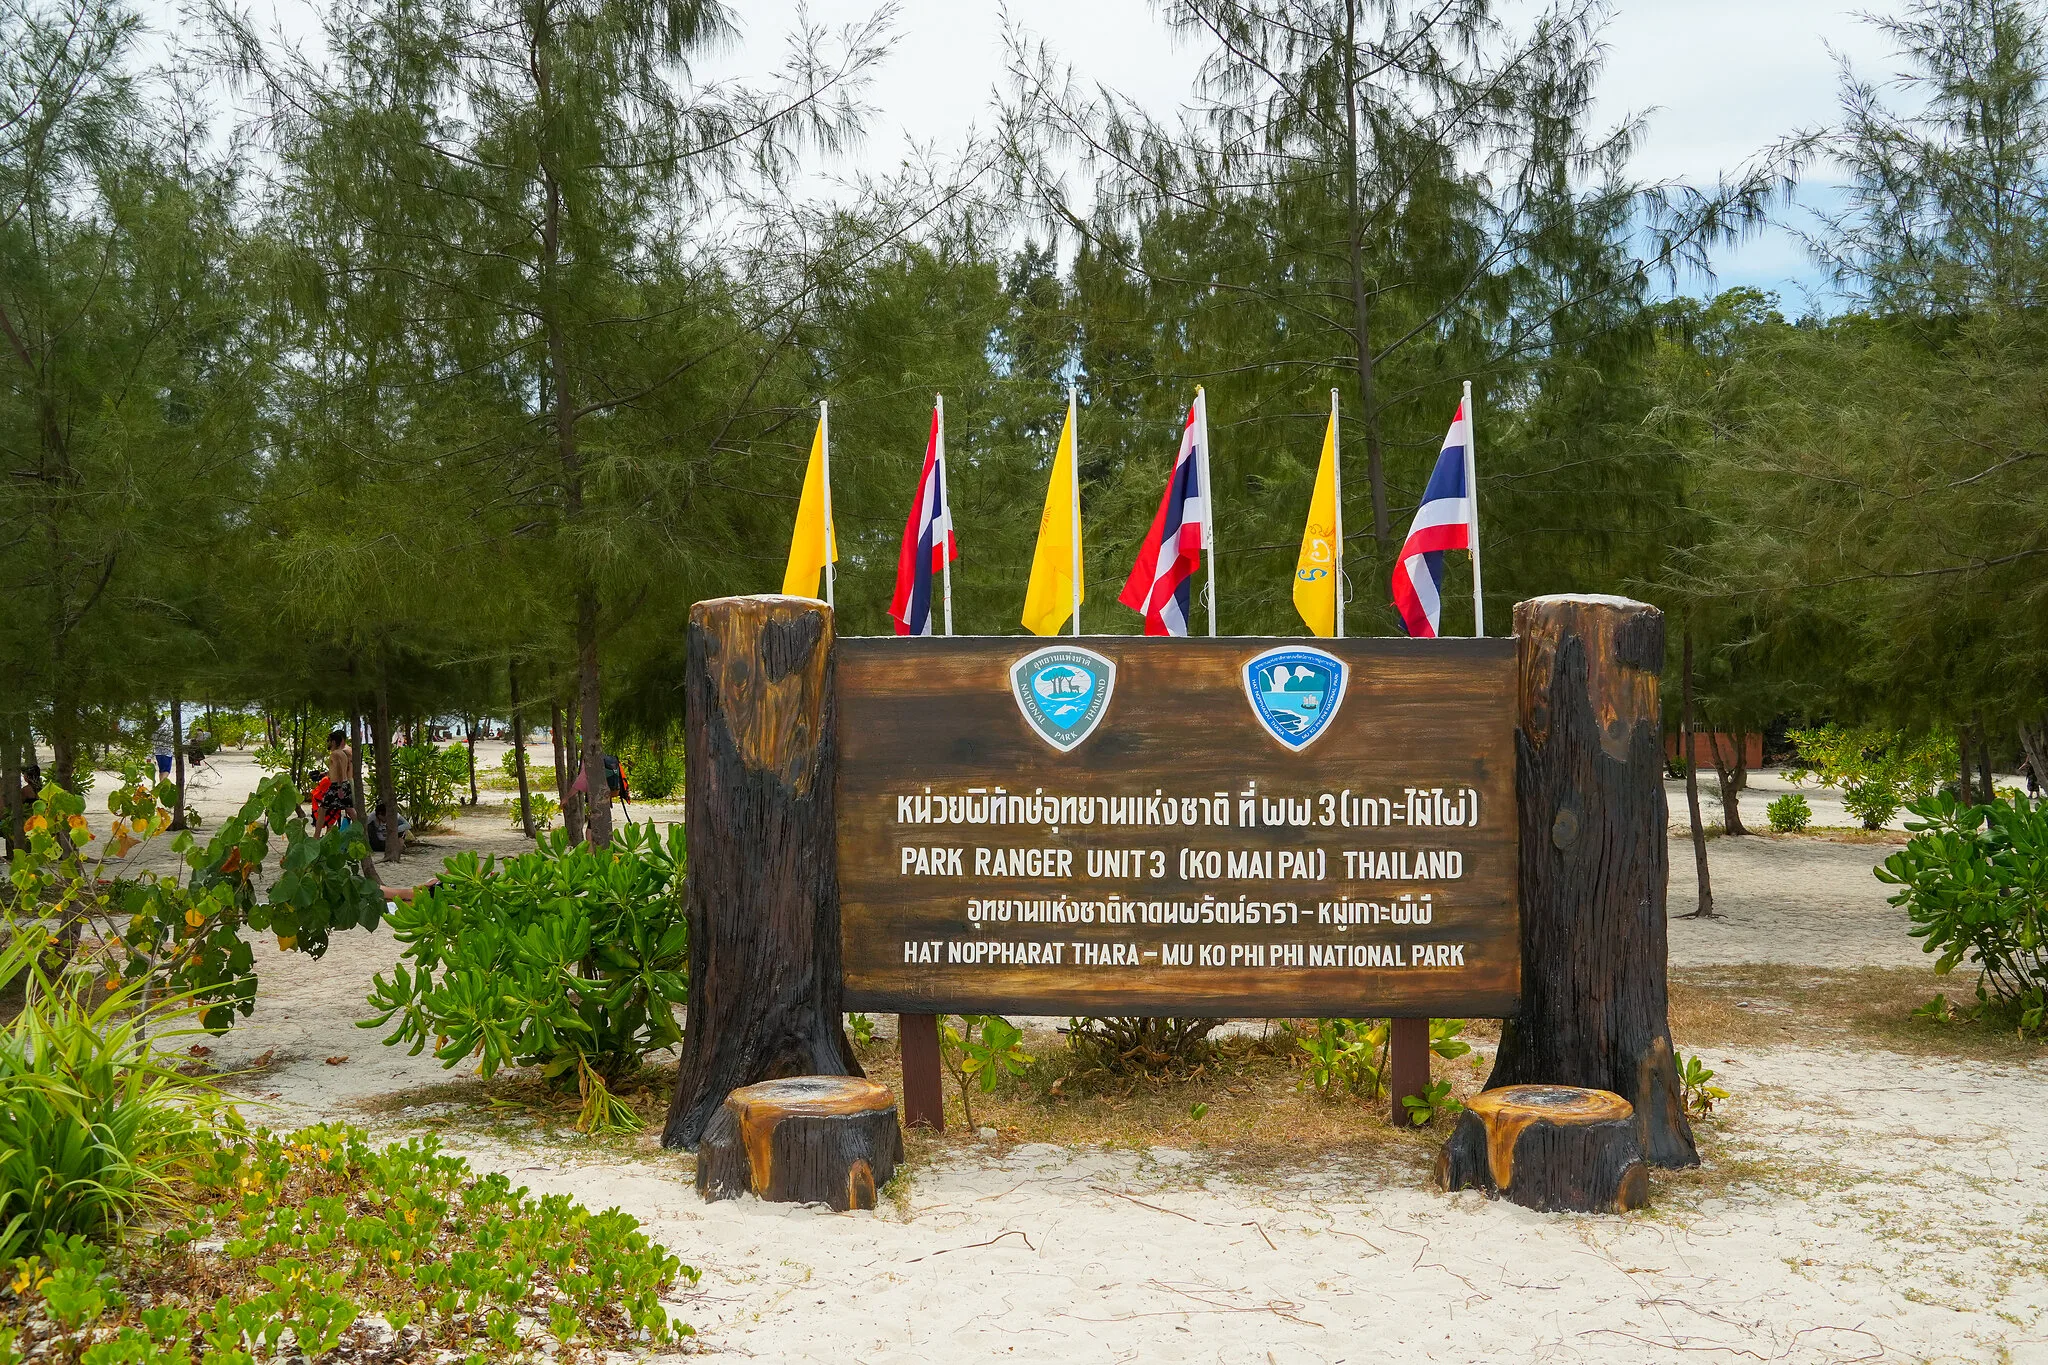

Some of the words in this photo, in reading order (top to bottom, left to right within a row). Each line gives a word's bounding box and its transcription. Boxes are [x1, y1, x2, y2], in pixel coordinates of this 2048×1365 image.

[1034, 652, 1093, 670] อุทยานแห่งชาติ
[1021, 683, 1047, 725] NATIONAL
[1084, 678, 1107, 722] THAILAND
[1054, 731, 1079, 741] PARK
[897, 786, 1230, 834] หน่วยพิทักษ์อุทยานแห่งชาติ
[1238, 781, 1256, 828] ที่
[901, 847, 964, 876] PARK
[974, 848, 1073, 877] RANGER
[1179, 847, 1222, 880] (KO
[1227, 850, 1272, 879] MAI
[1278, 847, 1326, 881] PAI)
[1342, 850, 1463, 880] THAILAND
[904, 941, 944, 964] HAT
[948, 941, 1065, 965] NOPPHARAT
[1071, 942, 1140, 966] THARA
[1162, 943, 1193, 966] MU
[1199, 944, 1226, 967] KO
[1230, 944, 1265, 967] PHI
[1269, 944, 1304, 967] PHI
[1309, 944, 1407, 967] NATIONAL
[1411, 944, 1465, 967] PARK
